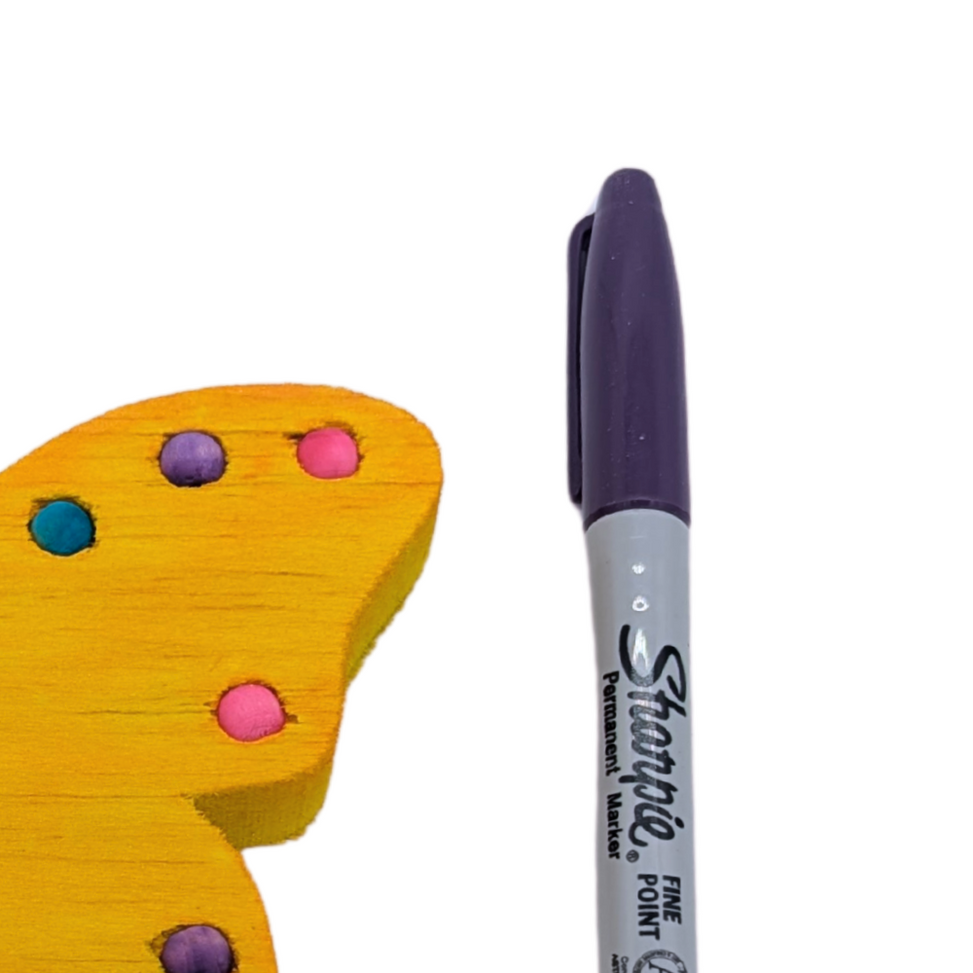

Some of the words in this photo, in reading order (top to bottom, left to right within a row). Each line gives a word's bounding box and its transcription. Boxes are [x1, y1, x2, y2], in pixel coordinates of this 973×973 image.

[603, 671, 621, 777] Permanent
[618, 624, 687, 848] Sharpie
[606, 791, 624, 860] Marker
[637, 873, 660, 941] POINT
[662, 875, 682, 925] FINE
